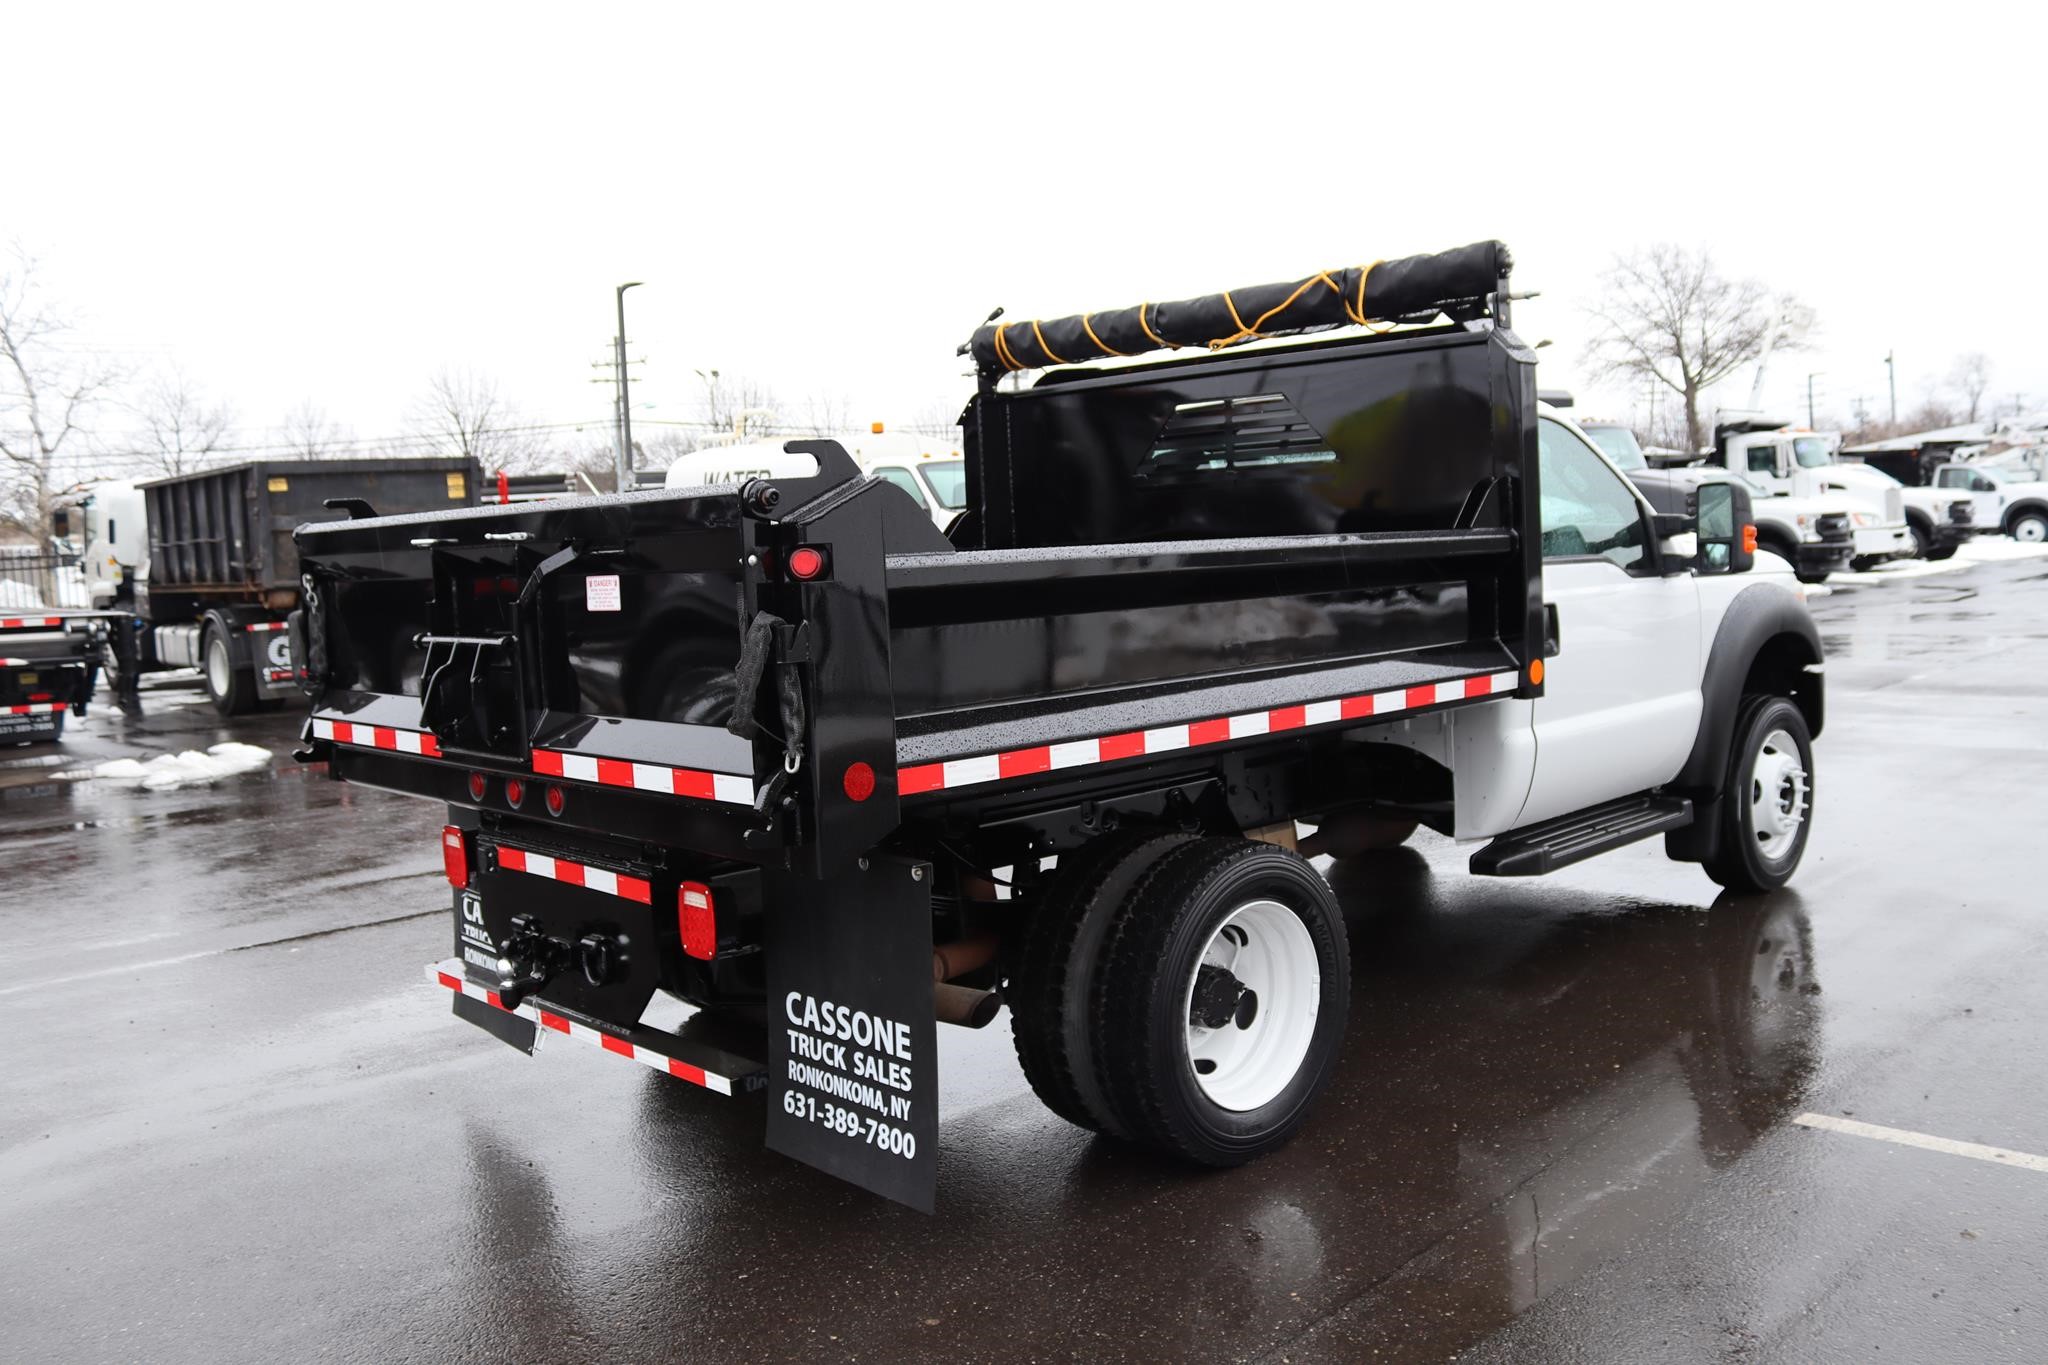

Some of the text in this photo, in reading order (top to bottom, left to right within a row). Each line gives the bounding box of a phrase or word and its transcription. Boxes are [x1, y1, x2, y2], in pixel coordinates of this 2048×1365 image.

[786, 991, 912, 1061] CASSONE
[787, 1029, 912, 1092] TRUCK SALES
[788, 1059, 911, 1121] RONKONKOMA, NY
[784, 1089, 916, 1160] 631-389-7800
